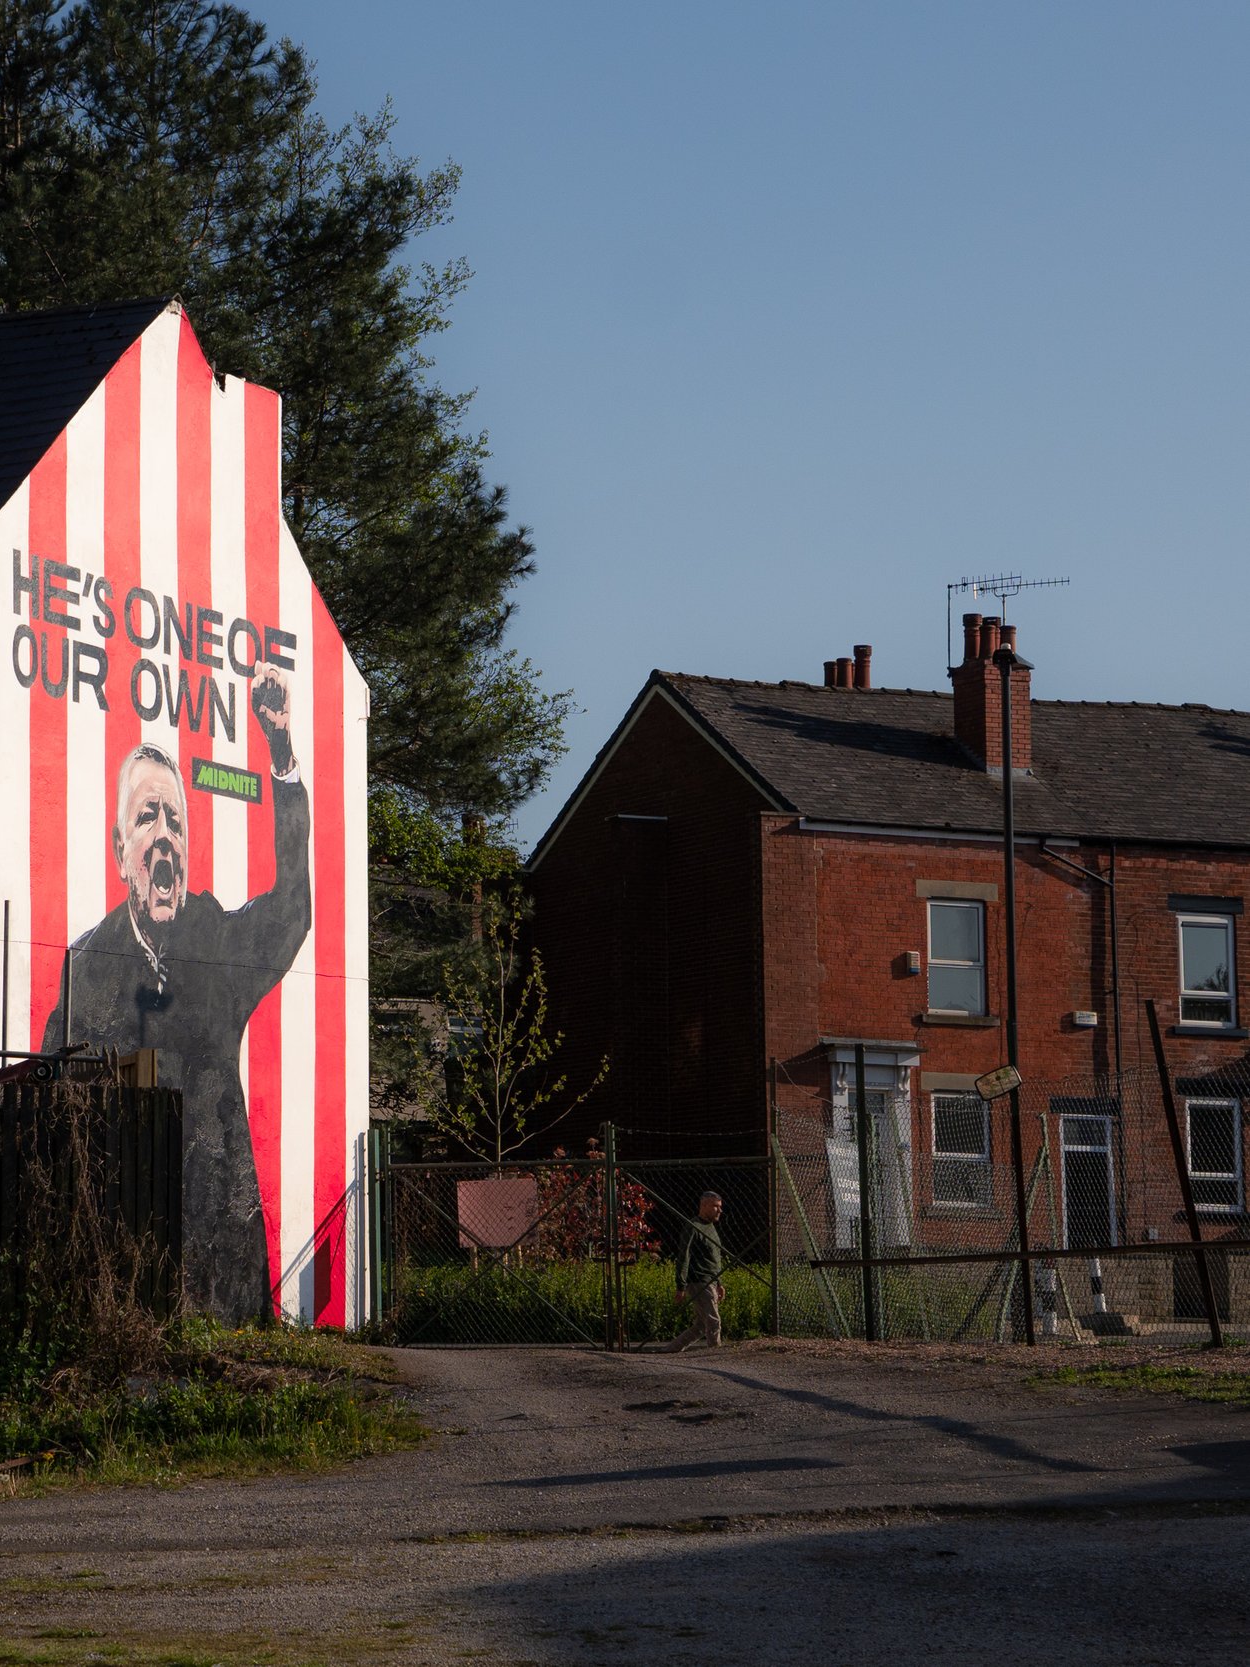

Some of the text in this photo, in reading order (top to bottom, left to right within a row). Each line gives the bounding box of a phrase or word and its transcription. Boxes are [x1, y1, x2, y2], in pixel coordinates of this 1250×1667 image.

[12, 548, 117, 639] HE'S
[124, 586, 224, 671] ONE
[12, 624, 236, 744] OUR OWN
[196, 764, 258, 798] MIDNITE
